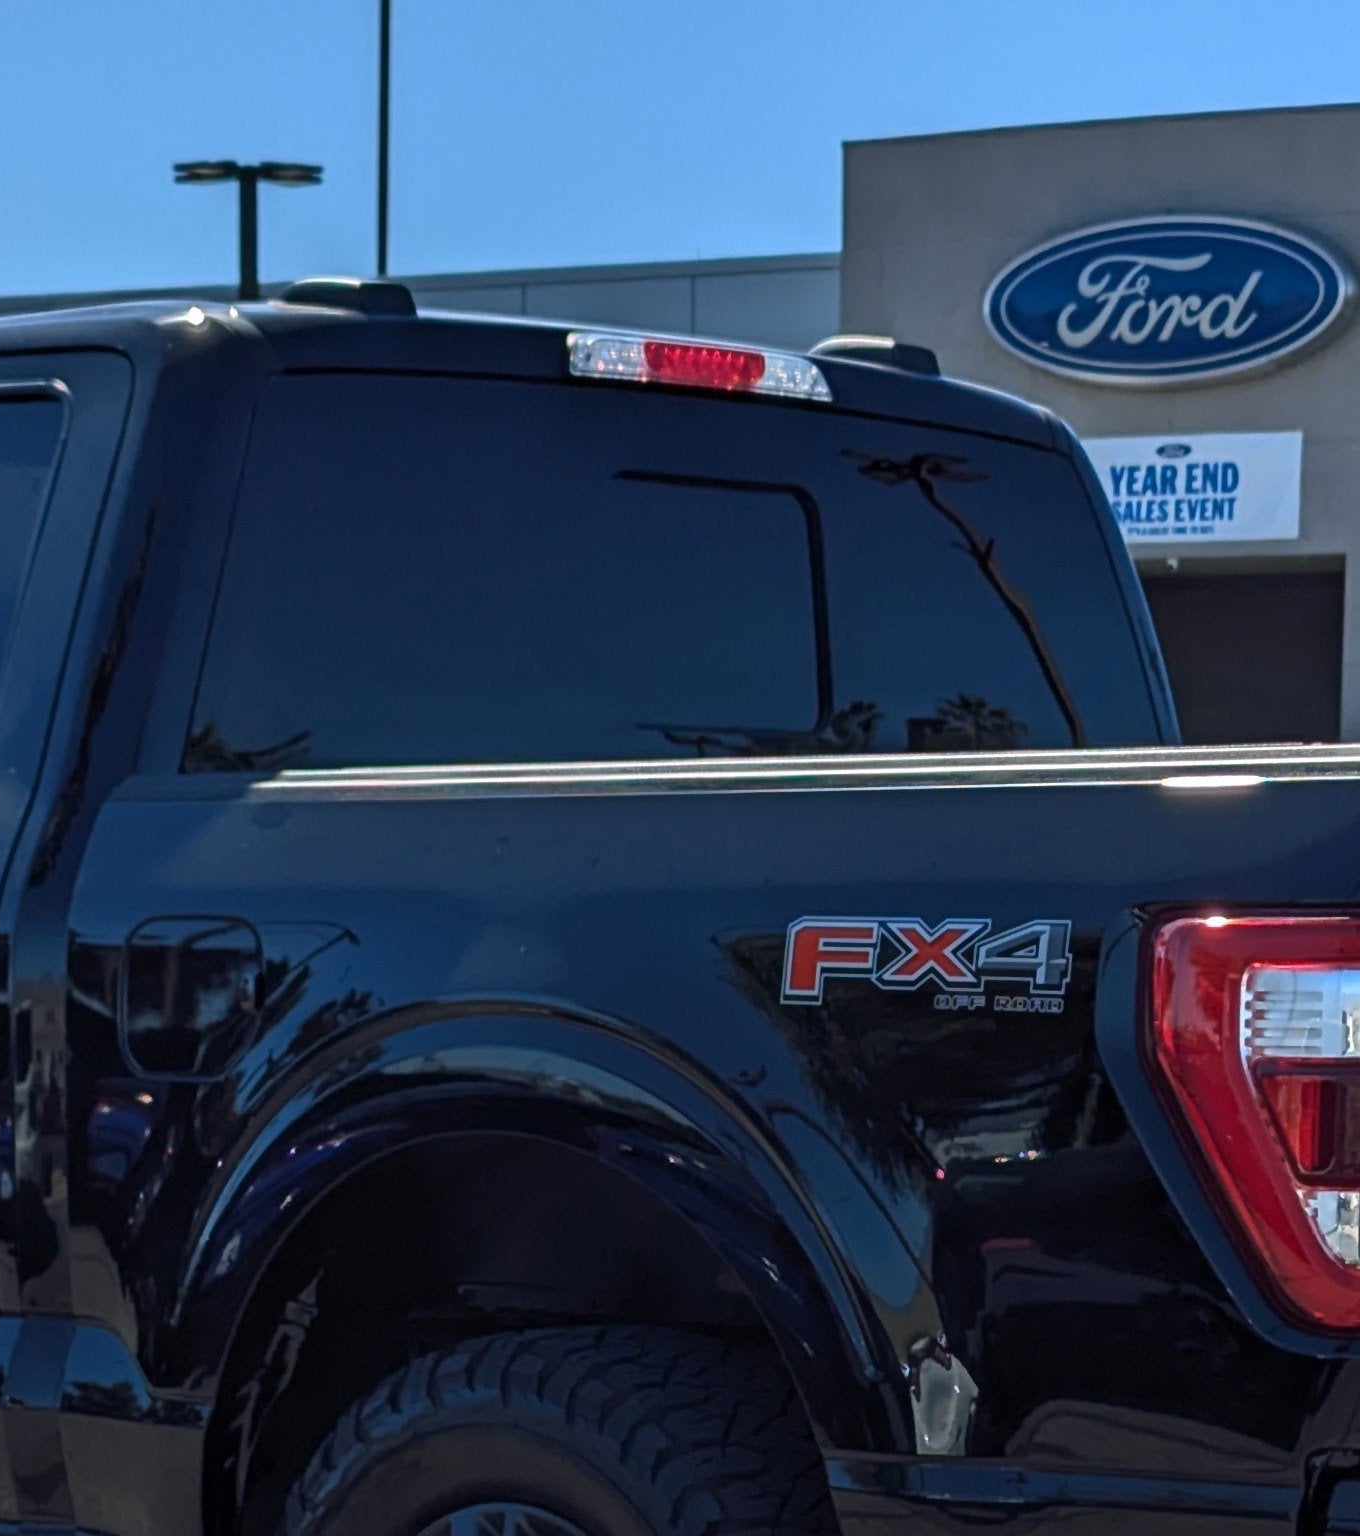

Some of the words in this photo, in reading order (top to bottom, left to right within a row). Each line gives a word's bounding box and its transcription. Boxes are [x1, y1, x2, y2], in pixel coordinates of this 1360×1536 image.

[1057, 253, 1264, 348] Ford
[1109, 464, 1178, 497] YEAR
[1184, 462, 1240, 495] END
[1111, 500, 1169, 523] SALES
[1174, 498, 1237, 522] EVENT
[780, 916, 1072, 1005] FX4
